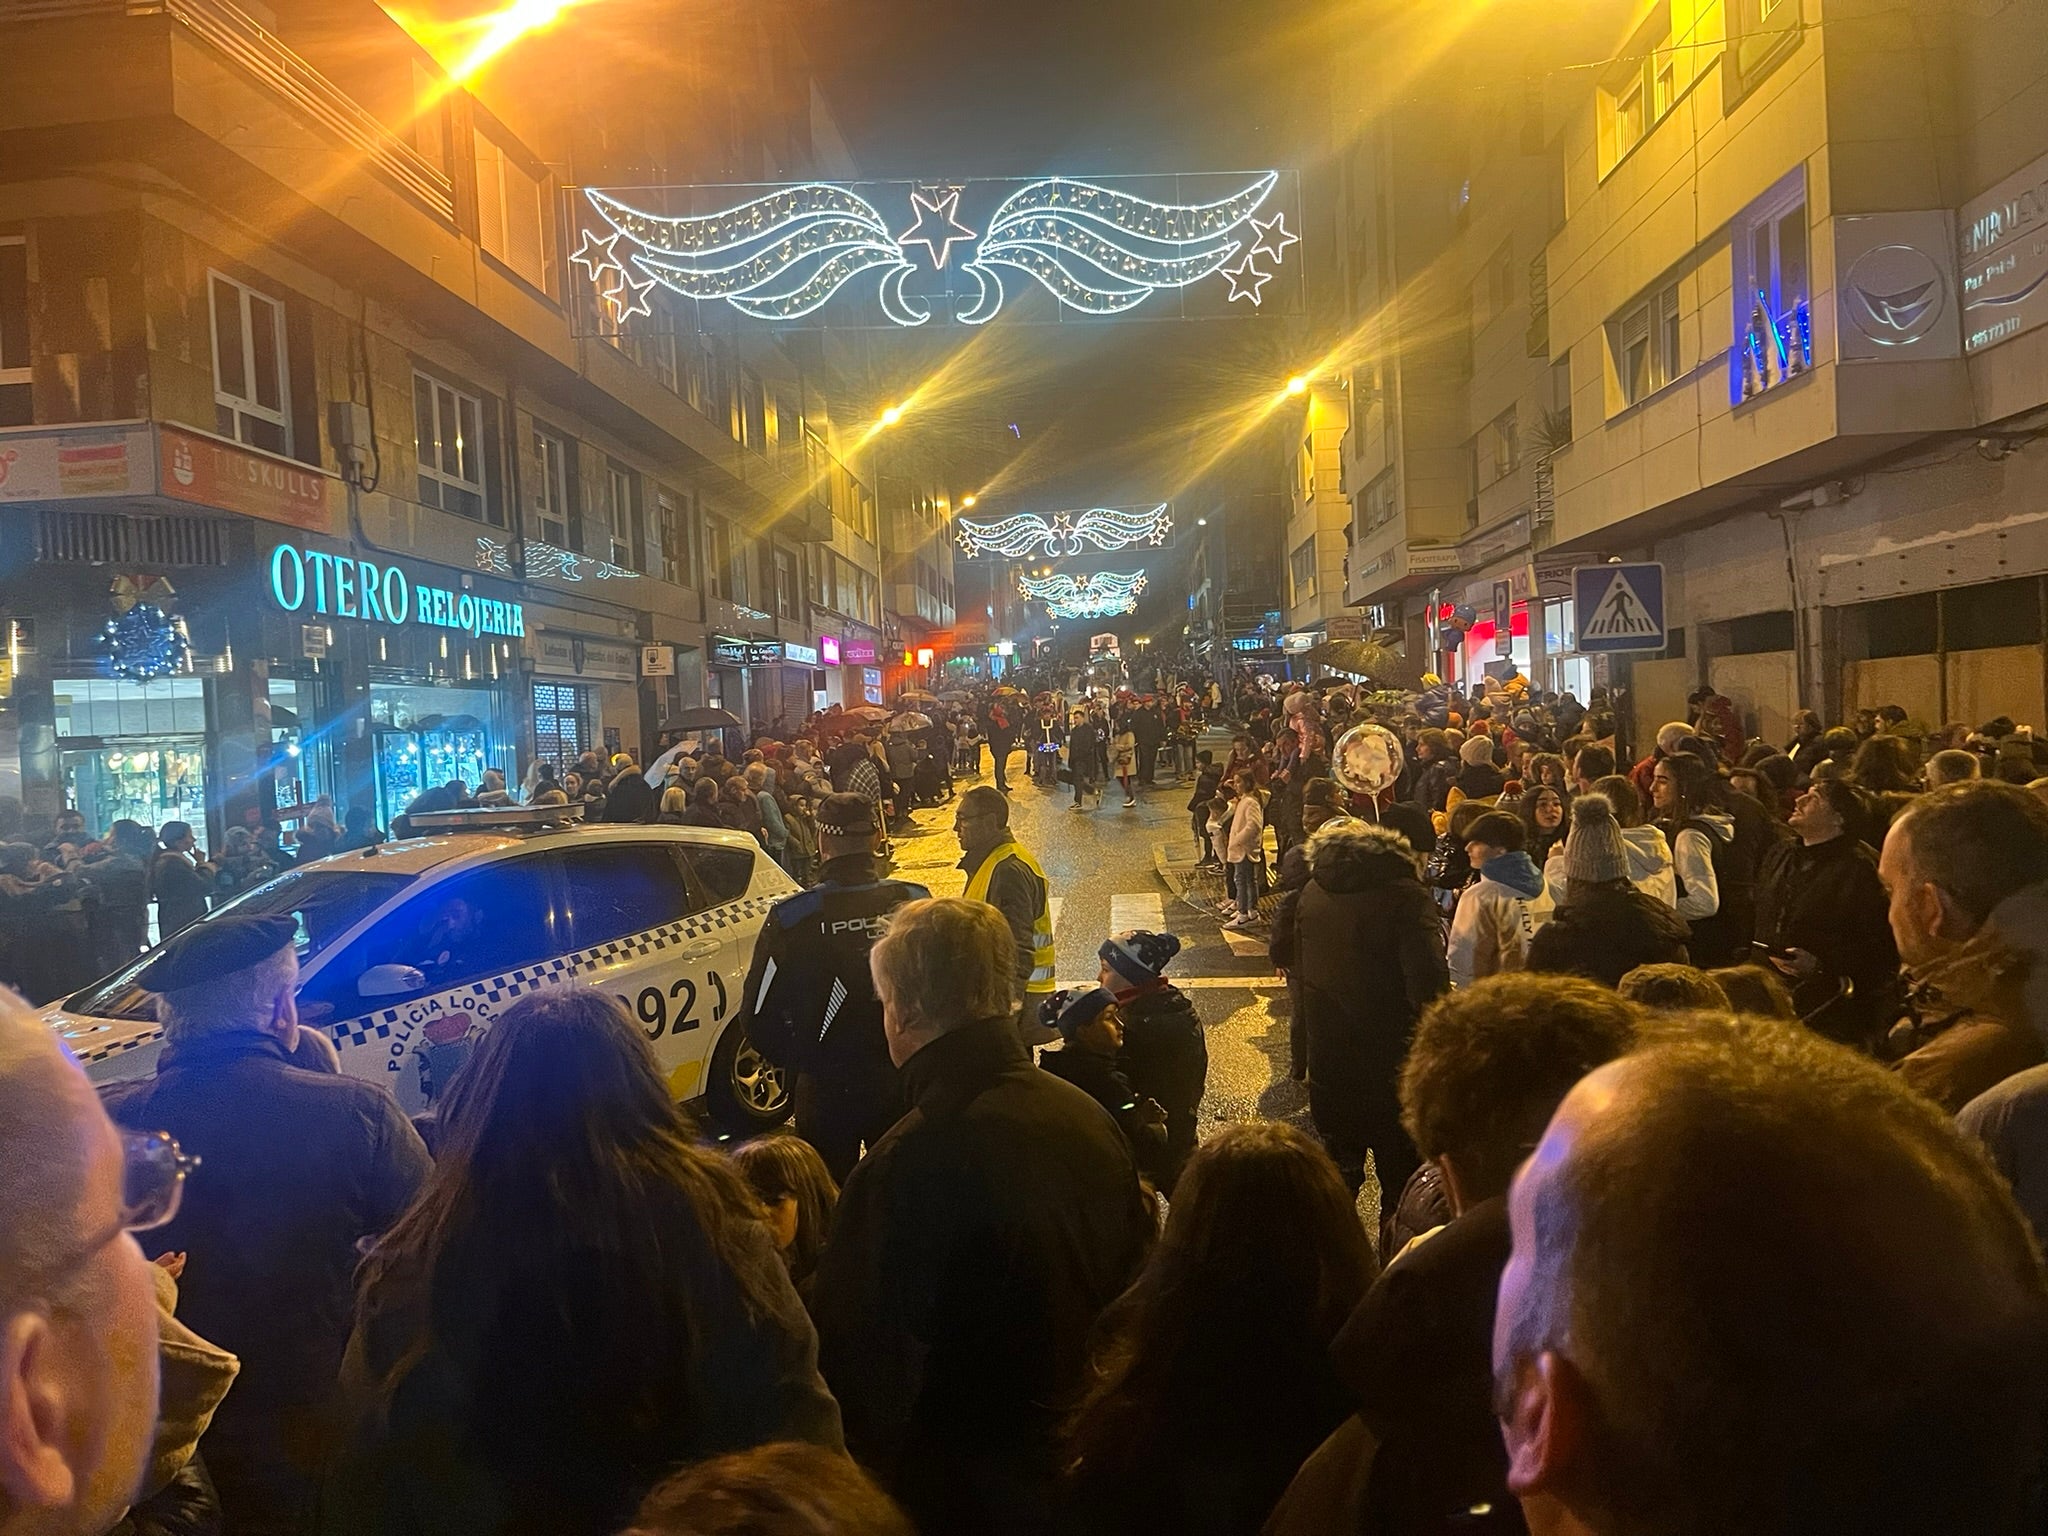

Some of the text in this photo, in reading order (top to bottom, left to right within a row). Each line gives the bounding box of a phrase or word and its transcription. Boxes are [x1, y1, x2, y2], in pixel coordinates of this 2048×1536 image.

[271, 543, 526, 639] OTERO RELOJERIA
[617, 978, 700, 1042] 92
